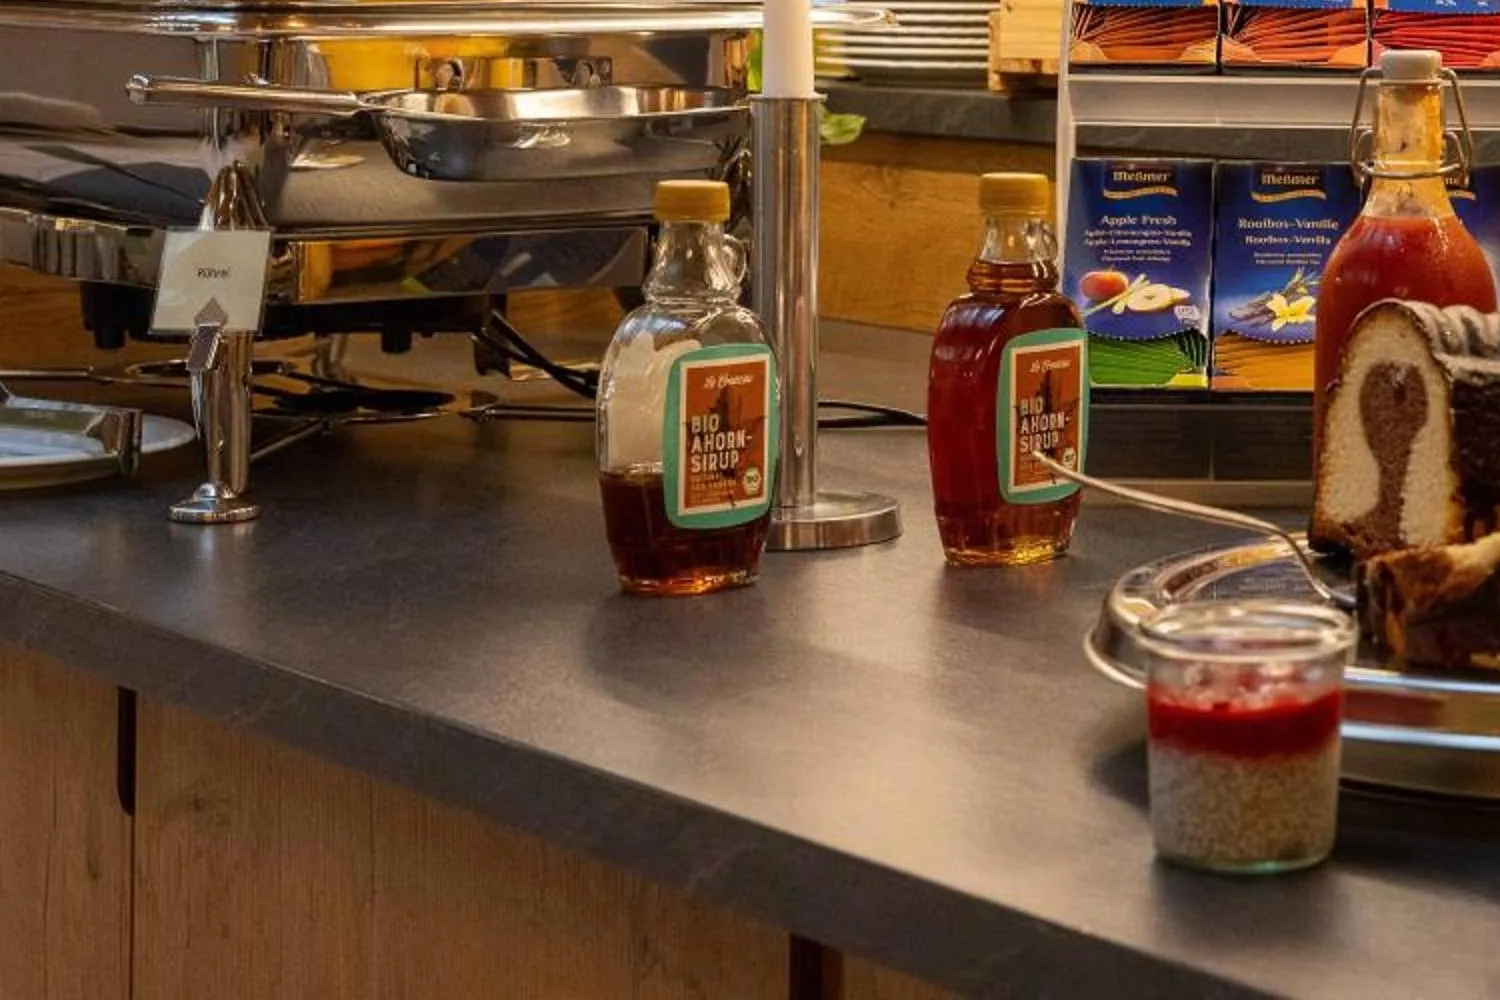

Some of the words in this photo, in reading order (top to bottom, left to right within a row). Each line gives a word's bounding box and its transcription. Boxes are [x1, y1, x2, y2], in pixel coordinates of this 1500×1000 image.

[1101, 215, 1138, 228] Apple
[1140, 215, 1178, 226] Fresh
[1020, 396, 1044, 416] BIO
[690, 413, 720, 433] BIO
[1020, 411, 1071, 435] AHORN-
[690, 429, 753, 454] AHORN-
[1019, 431, 1059, 453] SIRUP
[690, 449, 740, 474] SIRUP
